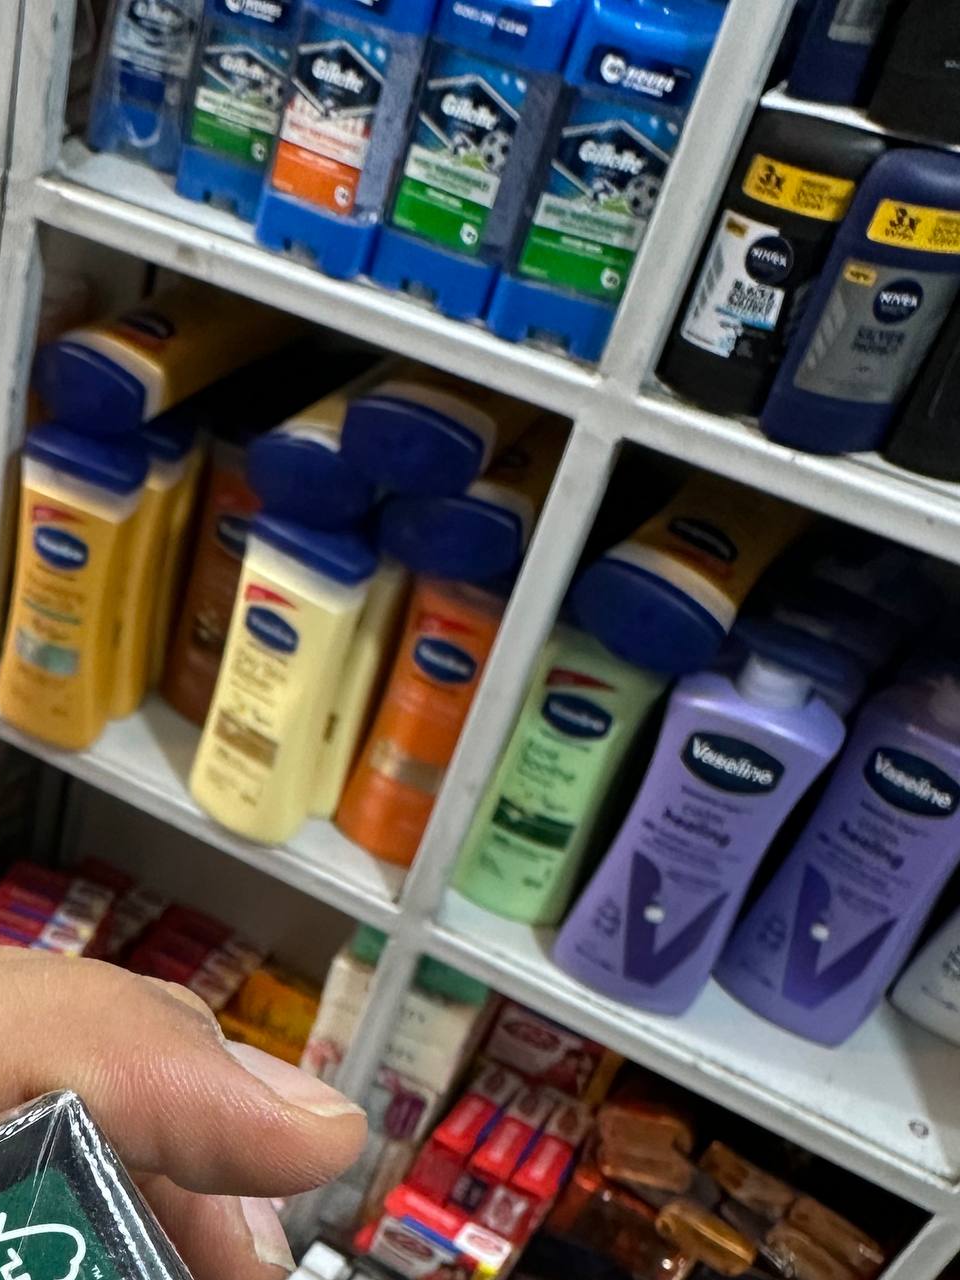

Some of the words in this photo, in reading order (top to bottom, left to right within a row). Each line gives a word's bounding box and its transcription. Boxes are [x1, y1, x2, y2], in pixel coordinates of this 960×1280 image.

[311, 57, 365, 95] Gillette
[440, 93, 499, 131] Gillette
[578, 140, 645, 176] Gillette
[691, 735, 775, 785] Vaseline
[874, 752, 954, 810] Vaseline
